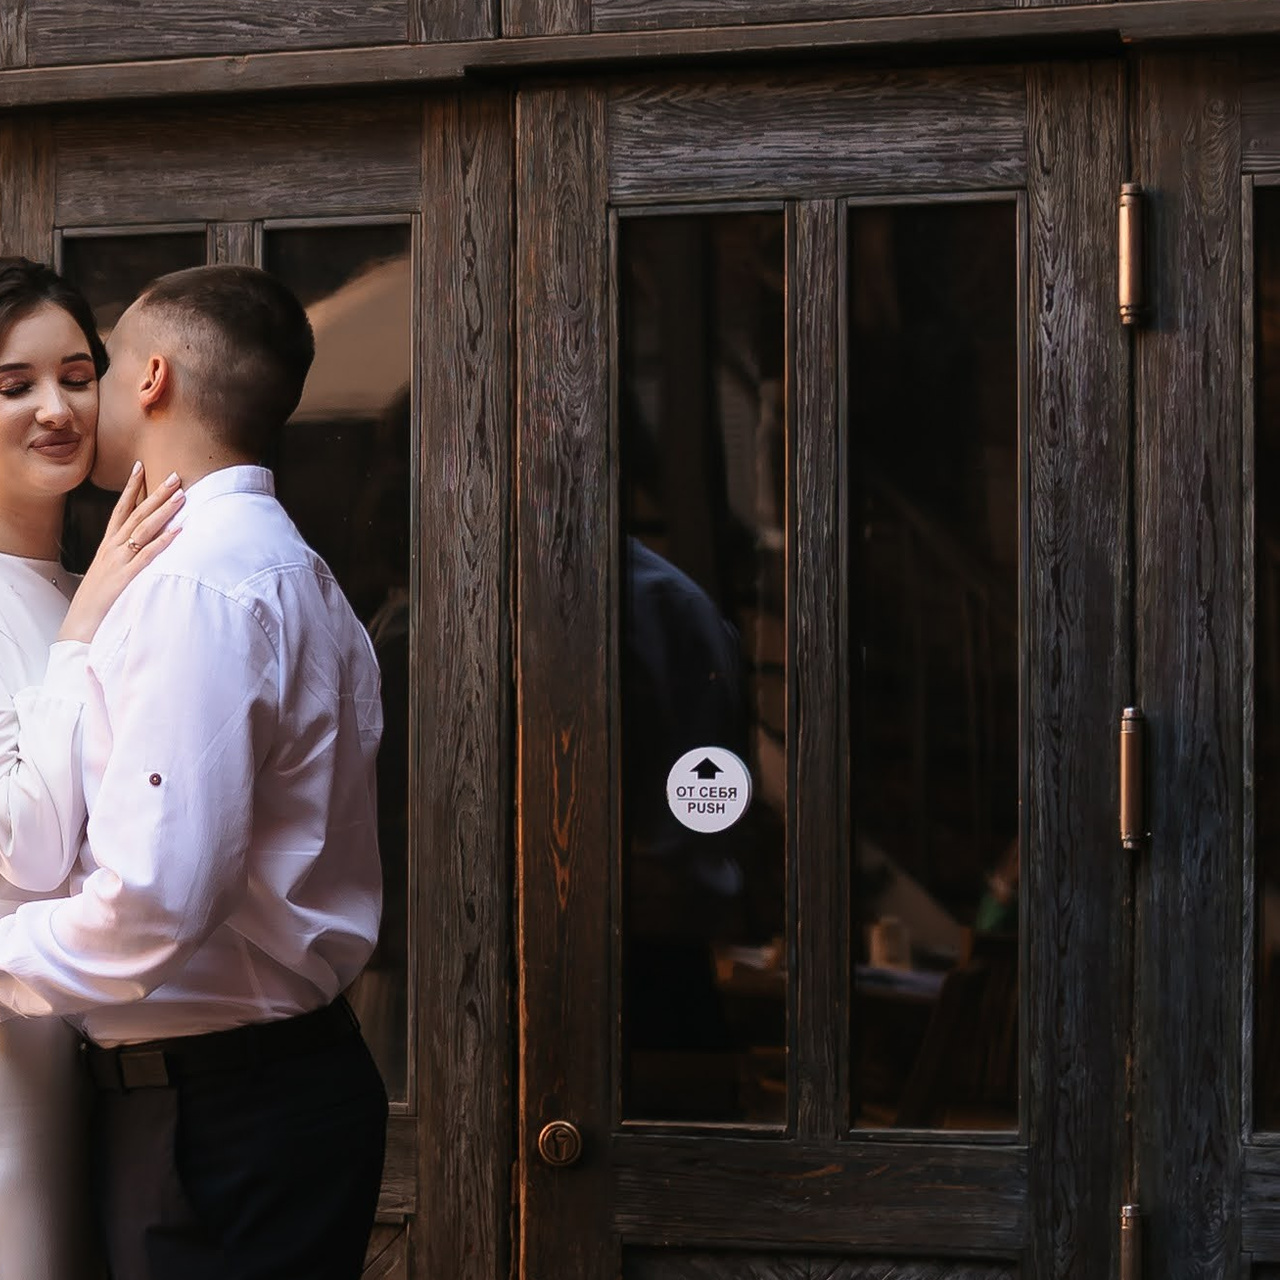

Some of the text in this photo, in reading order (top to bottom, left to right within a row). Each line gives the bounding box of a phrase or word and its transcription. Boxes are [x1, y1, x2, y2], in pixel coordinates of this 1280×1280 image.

[676, 786, 738, 799] ОТ СЕБЯ
[687, 802, 726, 814] PUSH
